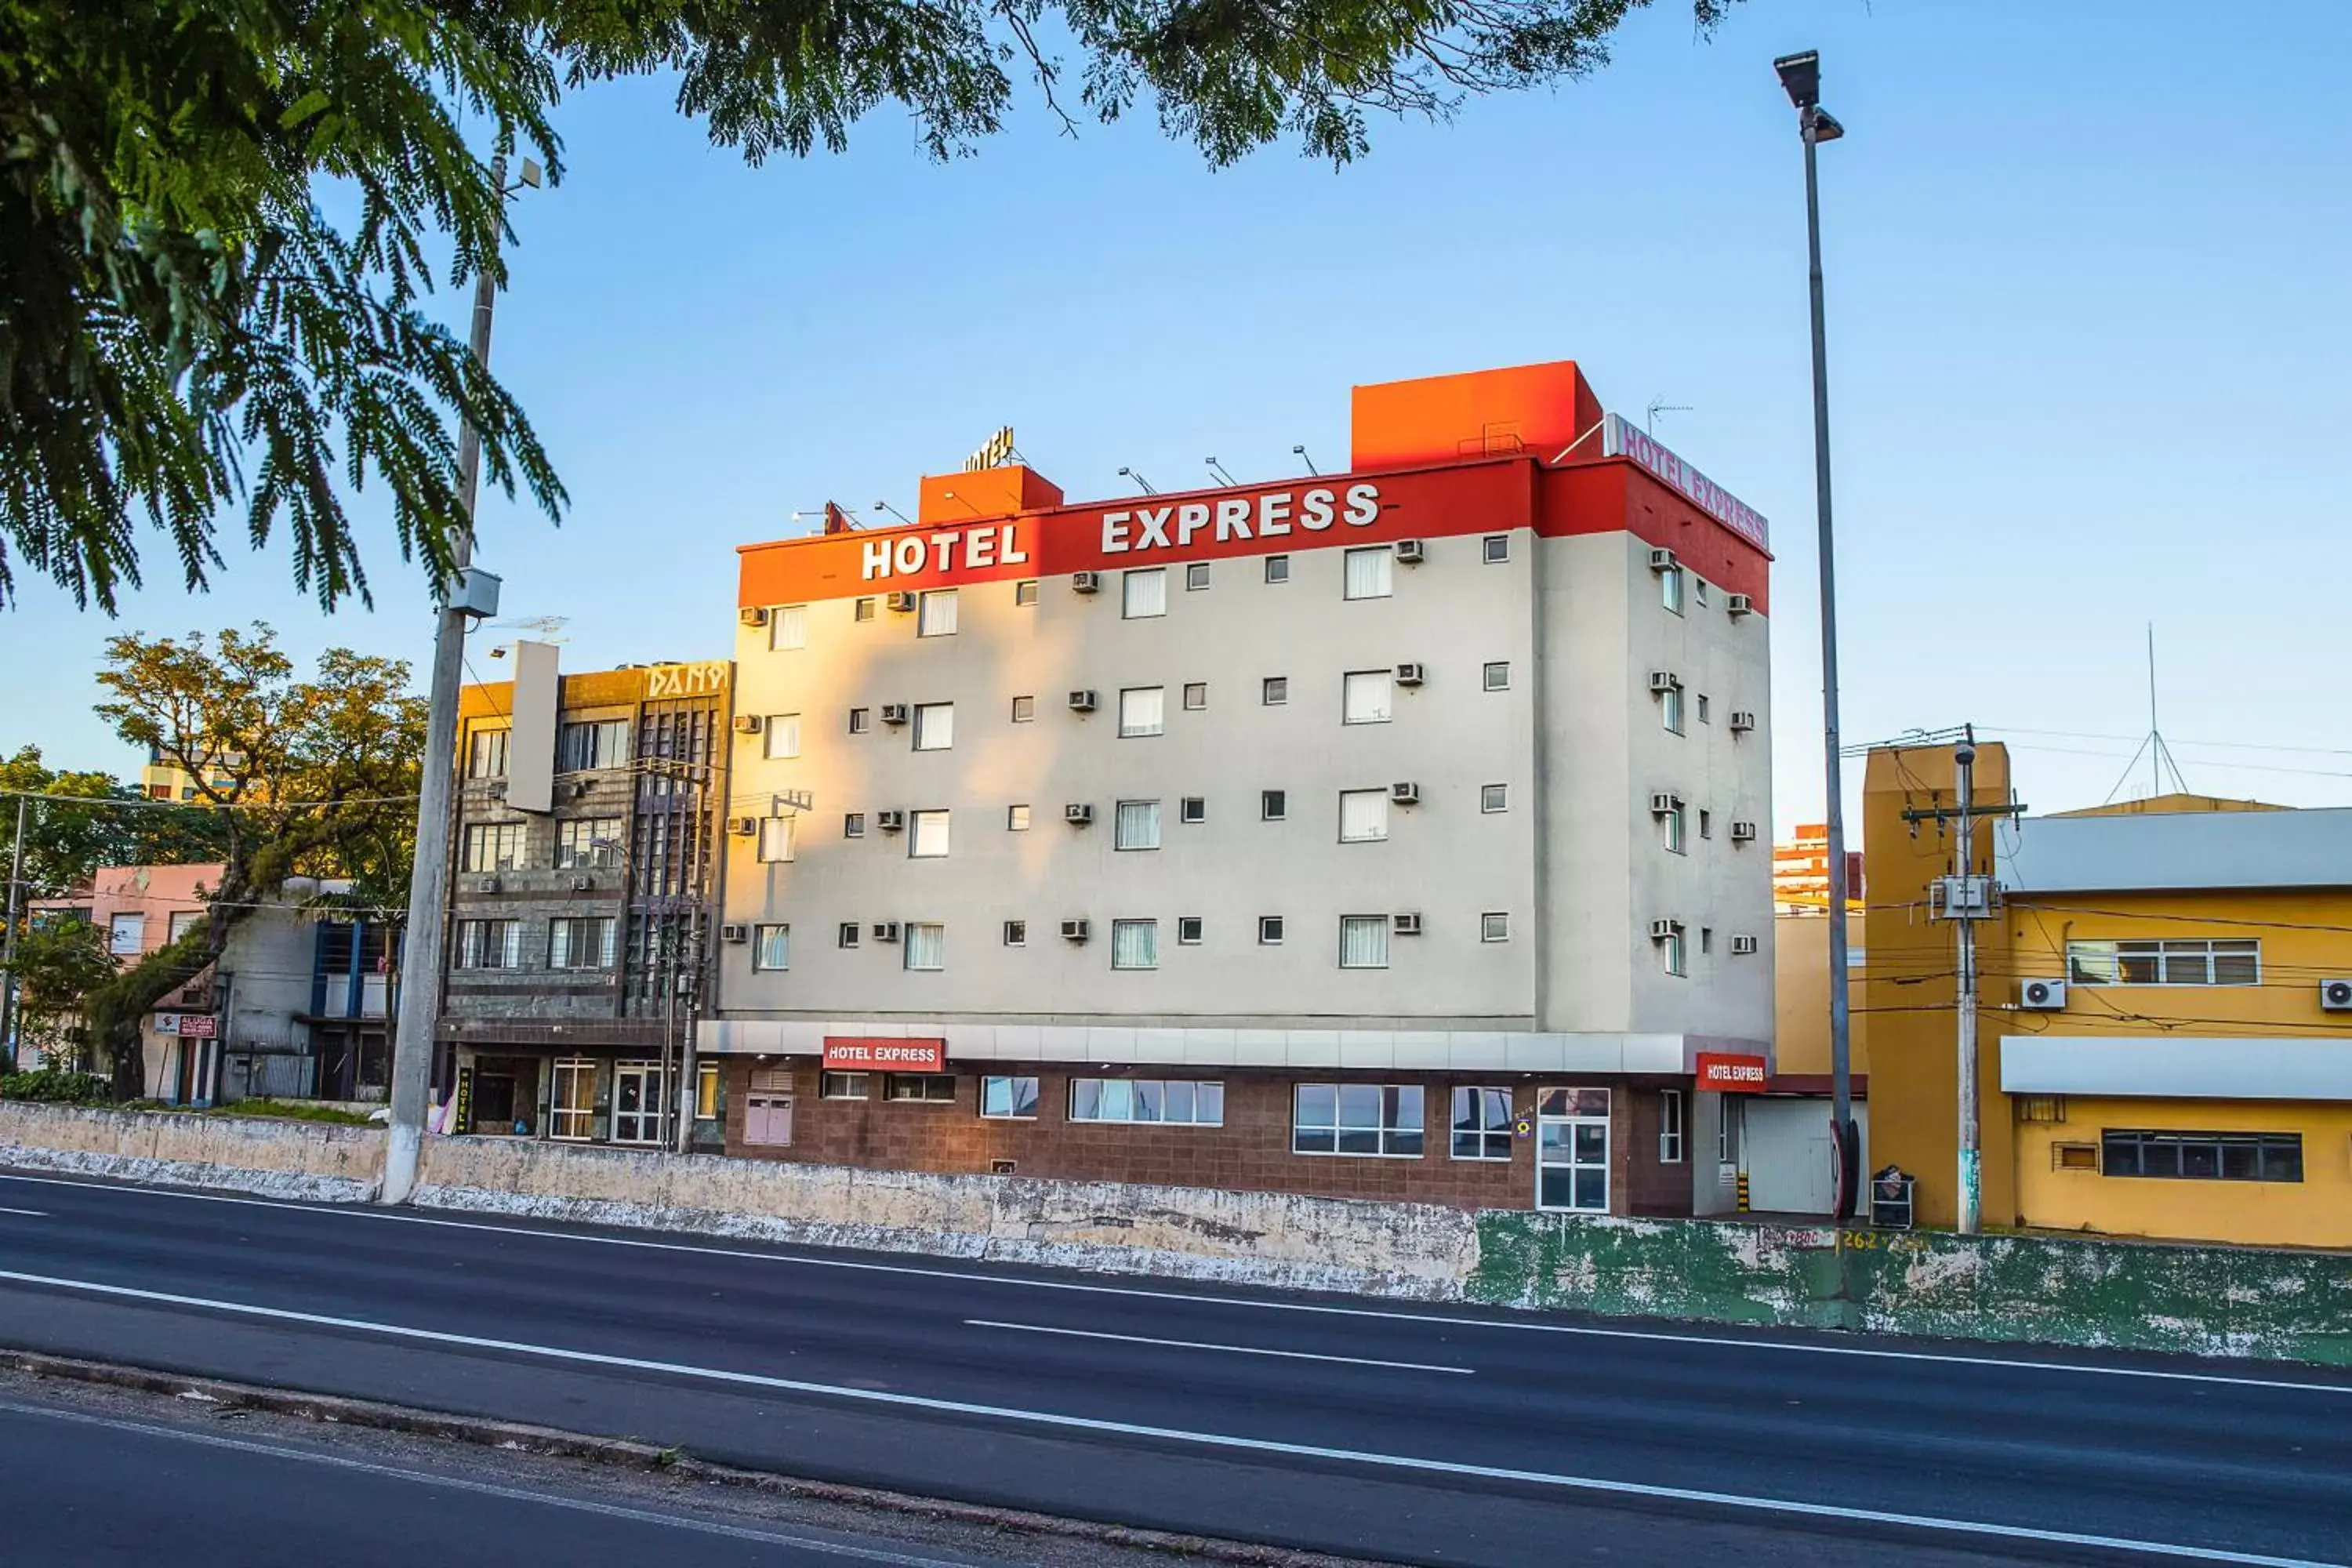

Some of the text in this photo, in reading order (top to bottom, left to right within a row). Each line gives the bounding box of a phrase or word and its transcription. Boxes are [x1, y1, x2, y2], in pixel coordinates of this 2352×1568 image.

[1623, 423, 1764, 542] HOTEL EXPRESS
[862, 484, 1379, 579] HOTEL EXPRESS
[829, 1047, 935, 1062] HOTEL EXPRESS
[1708, 1064, 1763, 1082] HOTEL EXPRESS
[459, 1081, 468, 1122] HOTEL
[1843, 1230, 1878, 1250] 262
